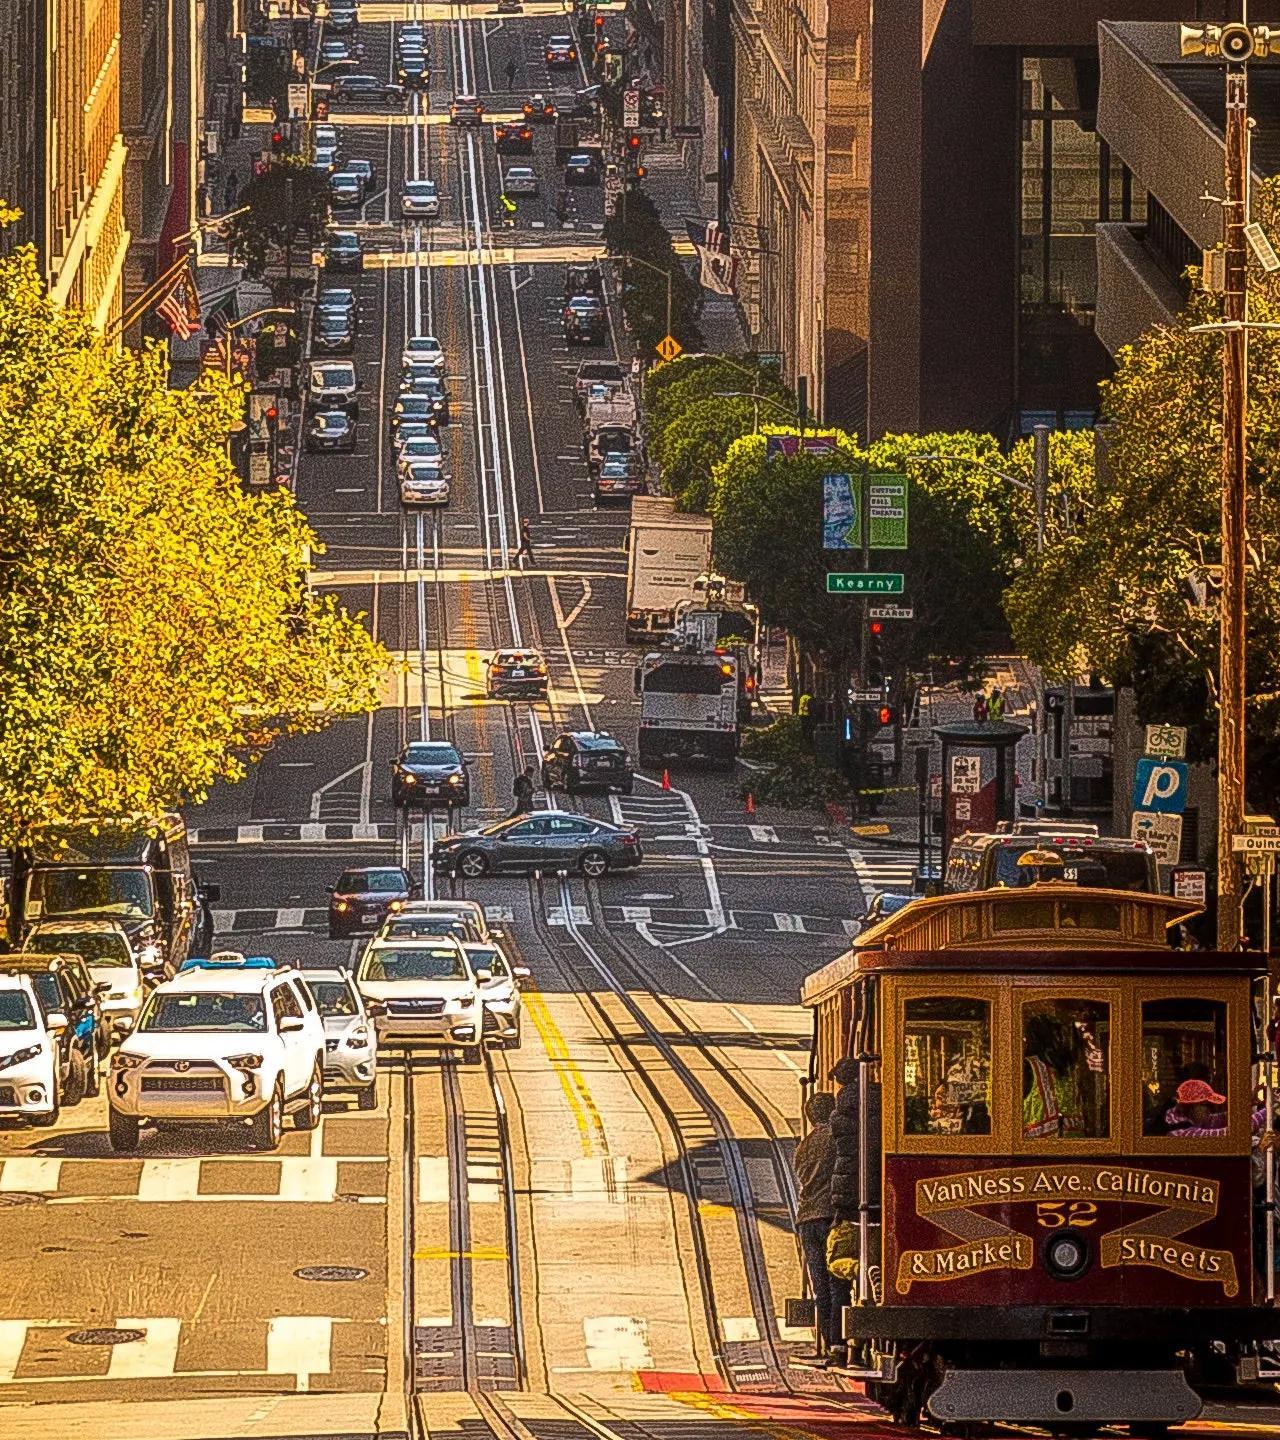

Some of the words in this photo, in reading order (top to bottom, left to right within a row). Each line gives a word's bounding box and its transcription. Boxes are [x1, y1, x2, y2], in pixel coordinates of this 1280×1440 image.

[836, 578, 895, 590] Kearny
[923, 1180, 966, 1204] Van
[967, 1175, 1025, 1200] Ness
[1095, 1170, 1215, 1204] California
[1035, 1201, 1099, 1228] 52
[912, 1253, 930, 1274] &
[936, 1240, 1022, 1273] Market
[1121, 1238, 1221, 1273] Streets
